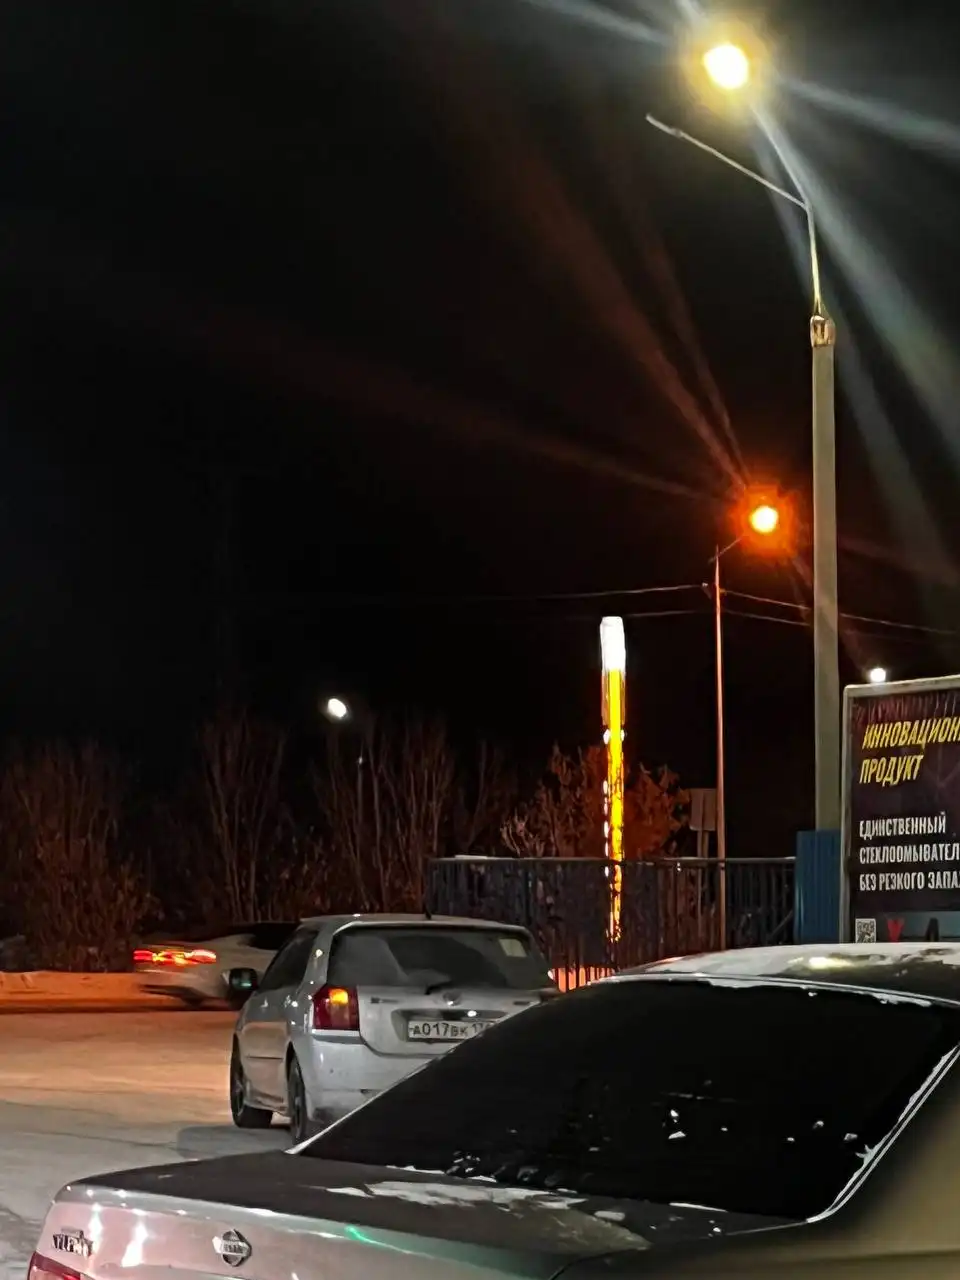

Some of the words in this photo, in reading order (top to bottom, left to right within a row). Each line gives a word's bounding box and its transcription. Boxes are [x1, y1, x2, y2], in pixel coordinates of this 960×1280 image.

[859, 754, 925, 787] ПРОДУКТ
[859, 811, 947, 840] ЕДИНСТВЕННЫЙ
[859, 873, 877, 891] БЕЗ
[879, 871, 925, 891] РЕЗКОГО
